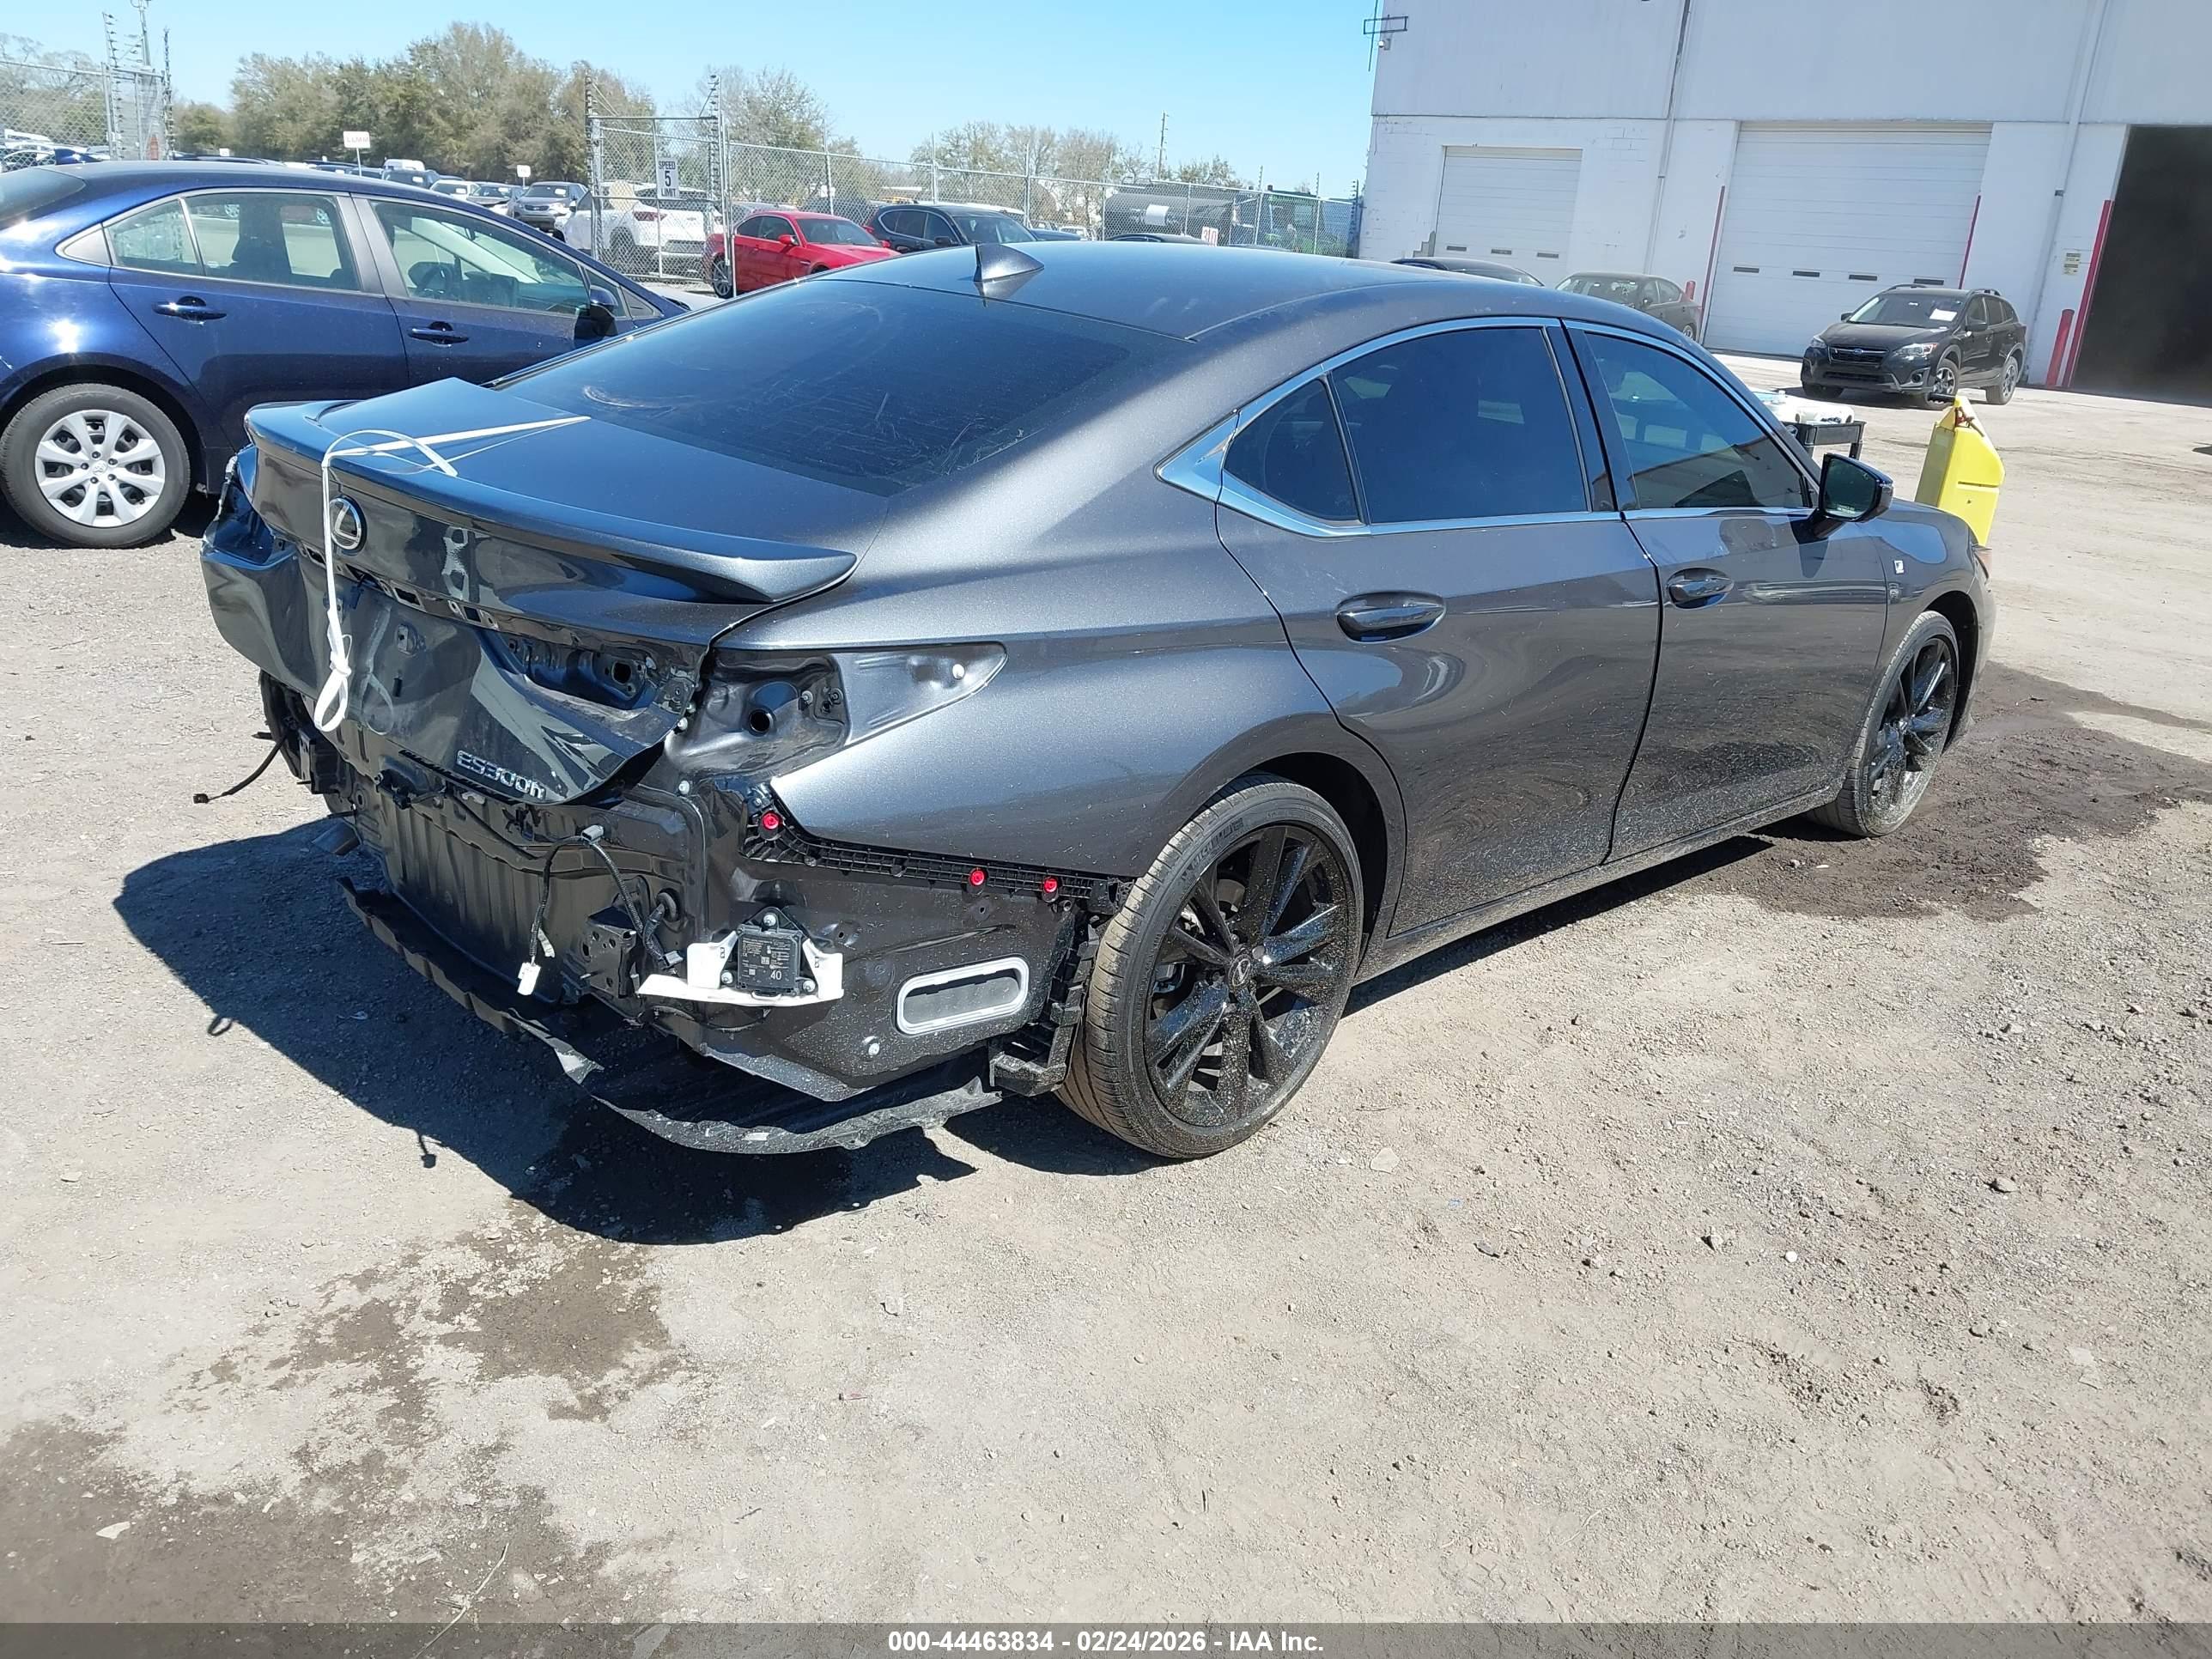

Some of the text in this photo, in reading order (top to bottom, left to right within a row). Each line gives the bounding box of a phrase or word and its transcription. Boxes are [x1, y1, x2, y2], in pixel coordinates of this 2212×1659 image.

[658, 161, 676, 170] SPEED
[665, 170, 672, 187] 5
[661, 188, 676, 198] LIMIT
[770, 969, 782, 981] 40
